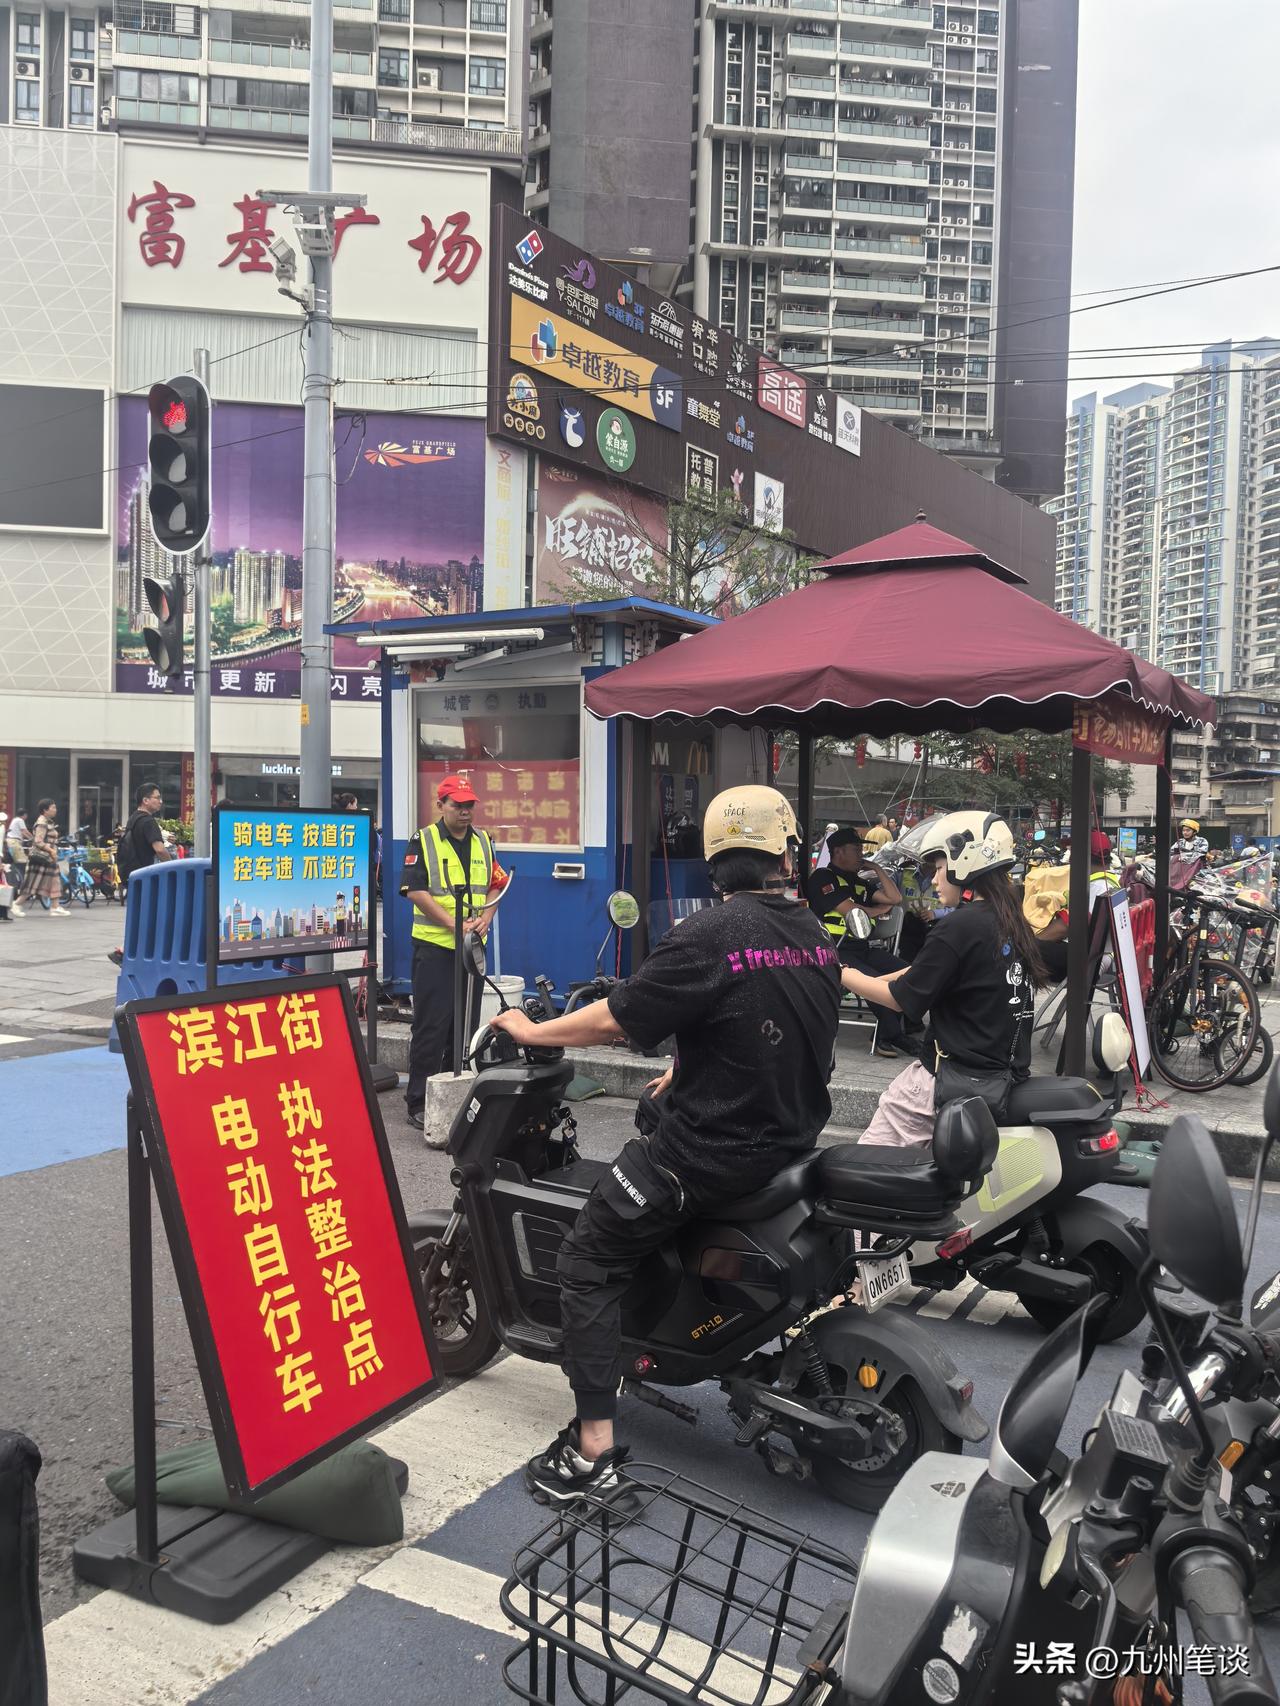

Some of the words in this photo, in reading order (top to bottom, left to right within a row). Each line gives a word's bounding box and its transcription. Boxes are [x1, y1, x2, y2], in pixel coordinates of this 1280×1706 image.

[127, 180, 482, 284] 富基广场
[558, 289, 596, 320] Y-SALON
[562, 341, 640, 398] 卓越教育
[656, 383, 674, 408] 3F
[762, 366, 803, 421] 高途
[412, 445, 456, 456] 富基广场
[262, 763, 293, 775] luckin
[723, 807, 746, 817] SPACE
[233, 822, 293, 848] 骑电车
[302, 823, 356, 848] 按道行
[233, 856, 293, 881] 控车速
[302, 856, 355, 880] 不逆行
[167, 993, 324, 1075] 滨江街
[277, 1079, 384, 1386] 执法整治点
[211, 1094, 324, 1414] 电动自行车
[869, 1263, 905, 1299] QN6651
